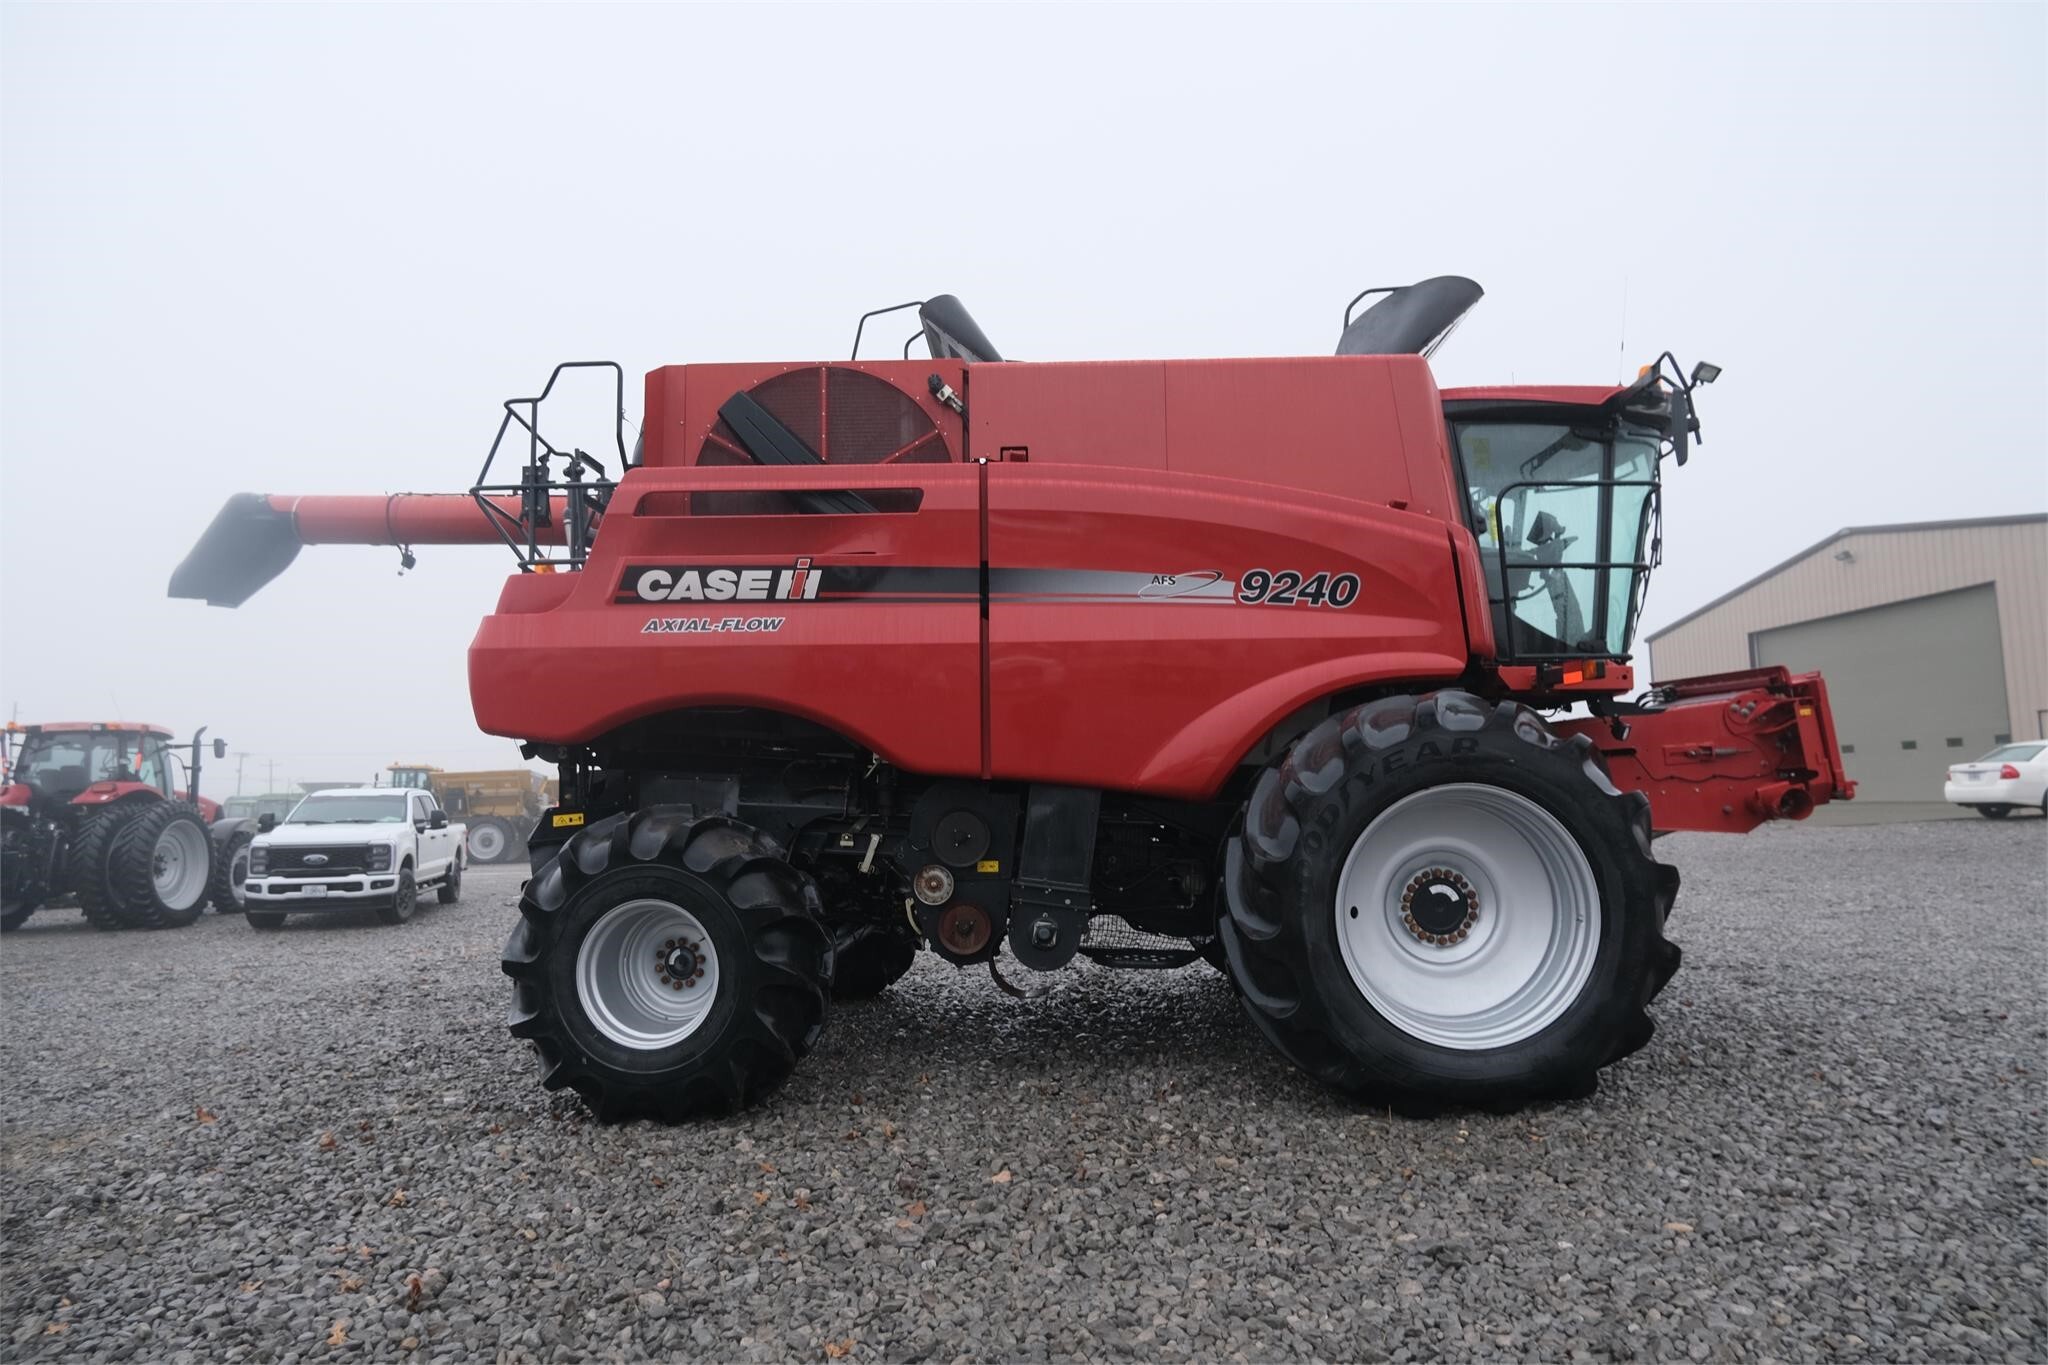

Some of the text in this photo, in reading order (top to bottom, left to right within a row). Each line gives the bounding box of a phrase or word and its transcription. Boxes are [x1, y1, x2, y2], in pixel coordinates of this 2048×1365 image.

[637, 569, 773, 601] CASE
[1151, 574, 1176, 586] AFS
[1238, 568, 1361, 609] 9240
[641, 617, 786, 634] AXIAL-FLOW
